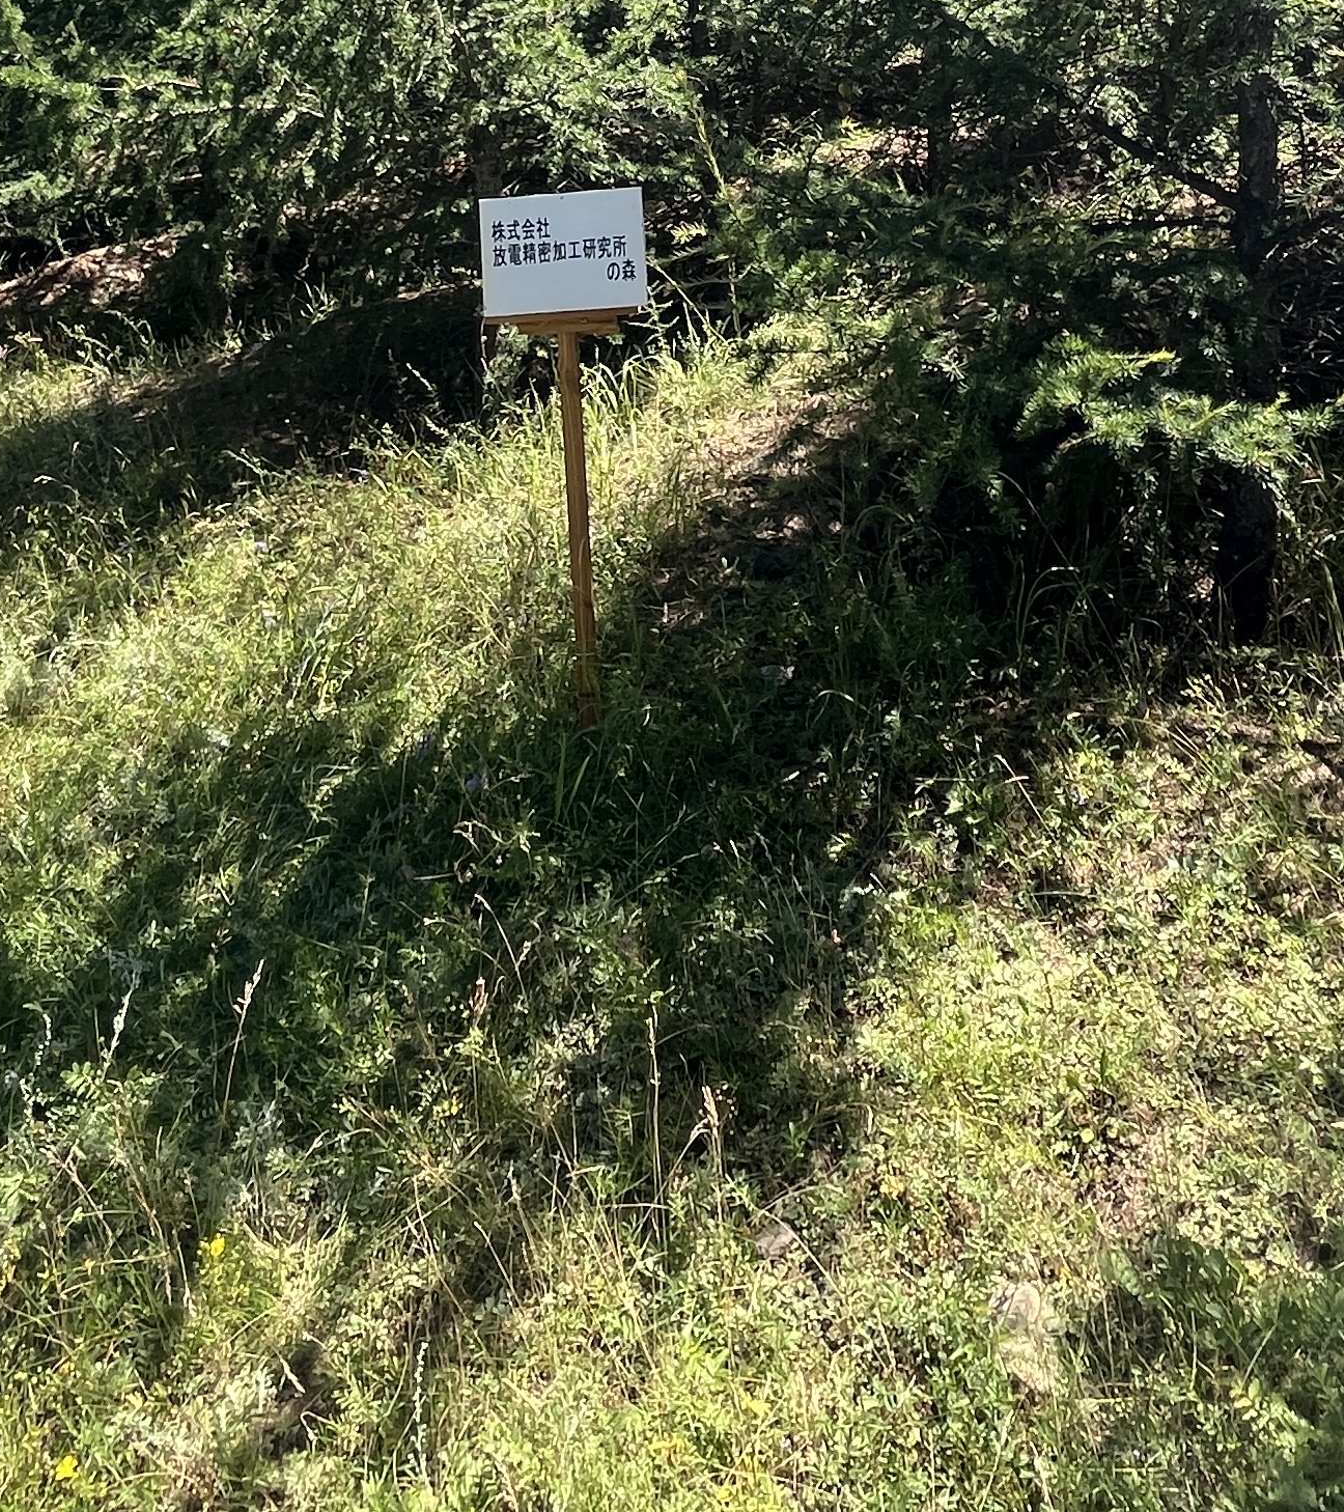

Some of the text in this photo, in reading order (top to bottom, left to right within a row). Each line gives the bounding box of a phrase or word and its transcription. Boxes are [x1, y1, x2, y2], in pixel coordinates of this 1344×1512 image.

[491, 217, 551, 241] 株式会社
[493, 235, 627, 267] 放電精密加工研究所
[607, 259, 637, 282] の森
